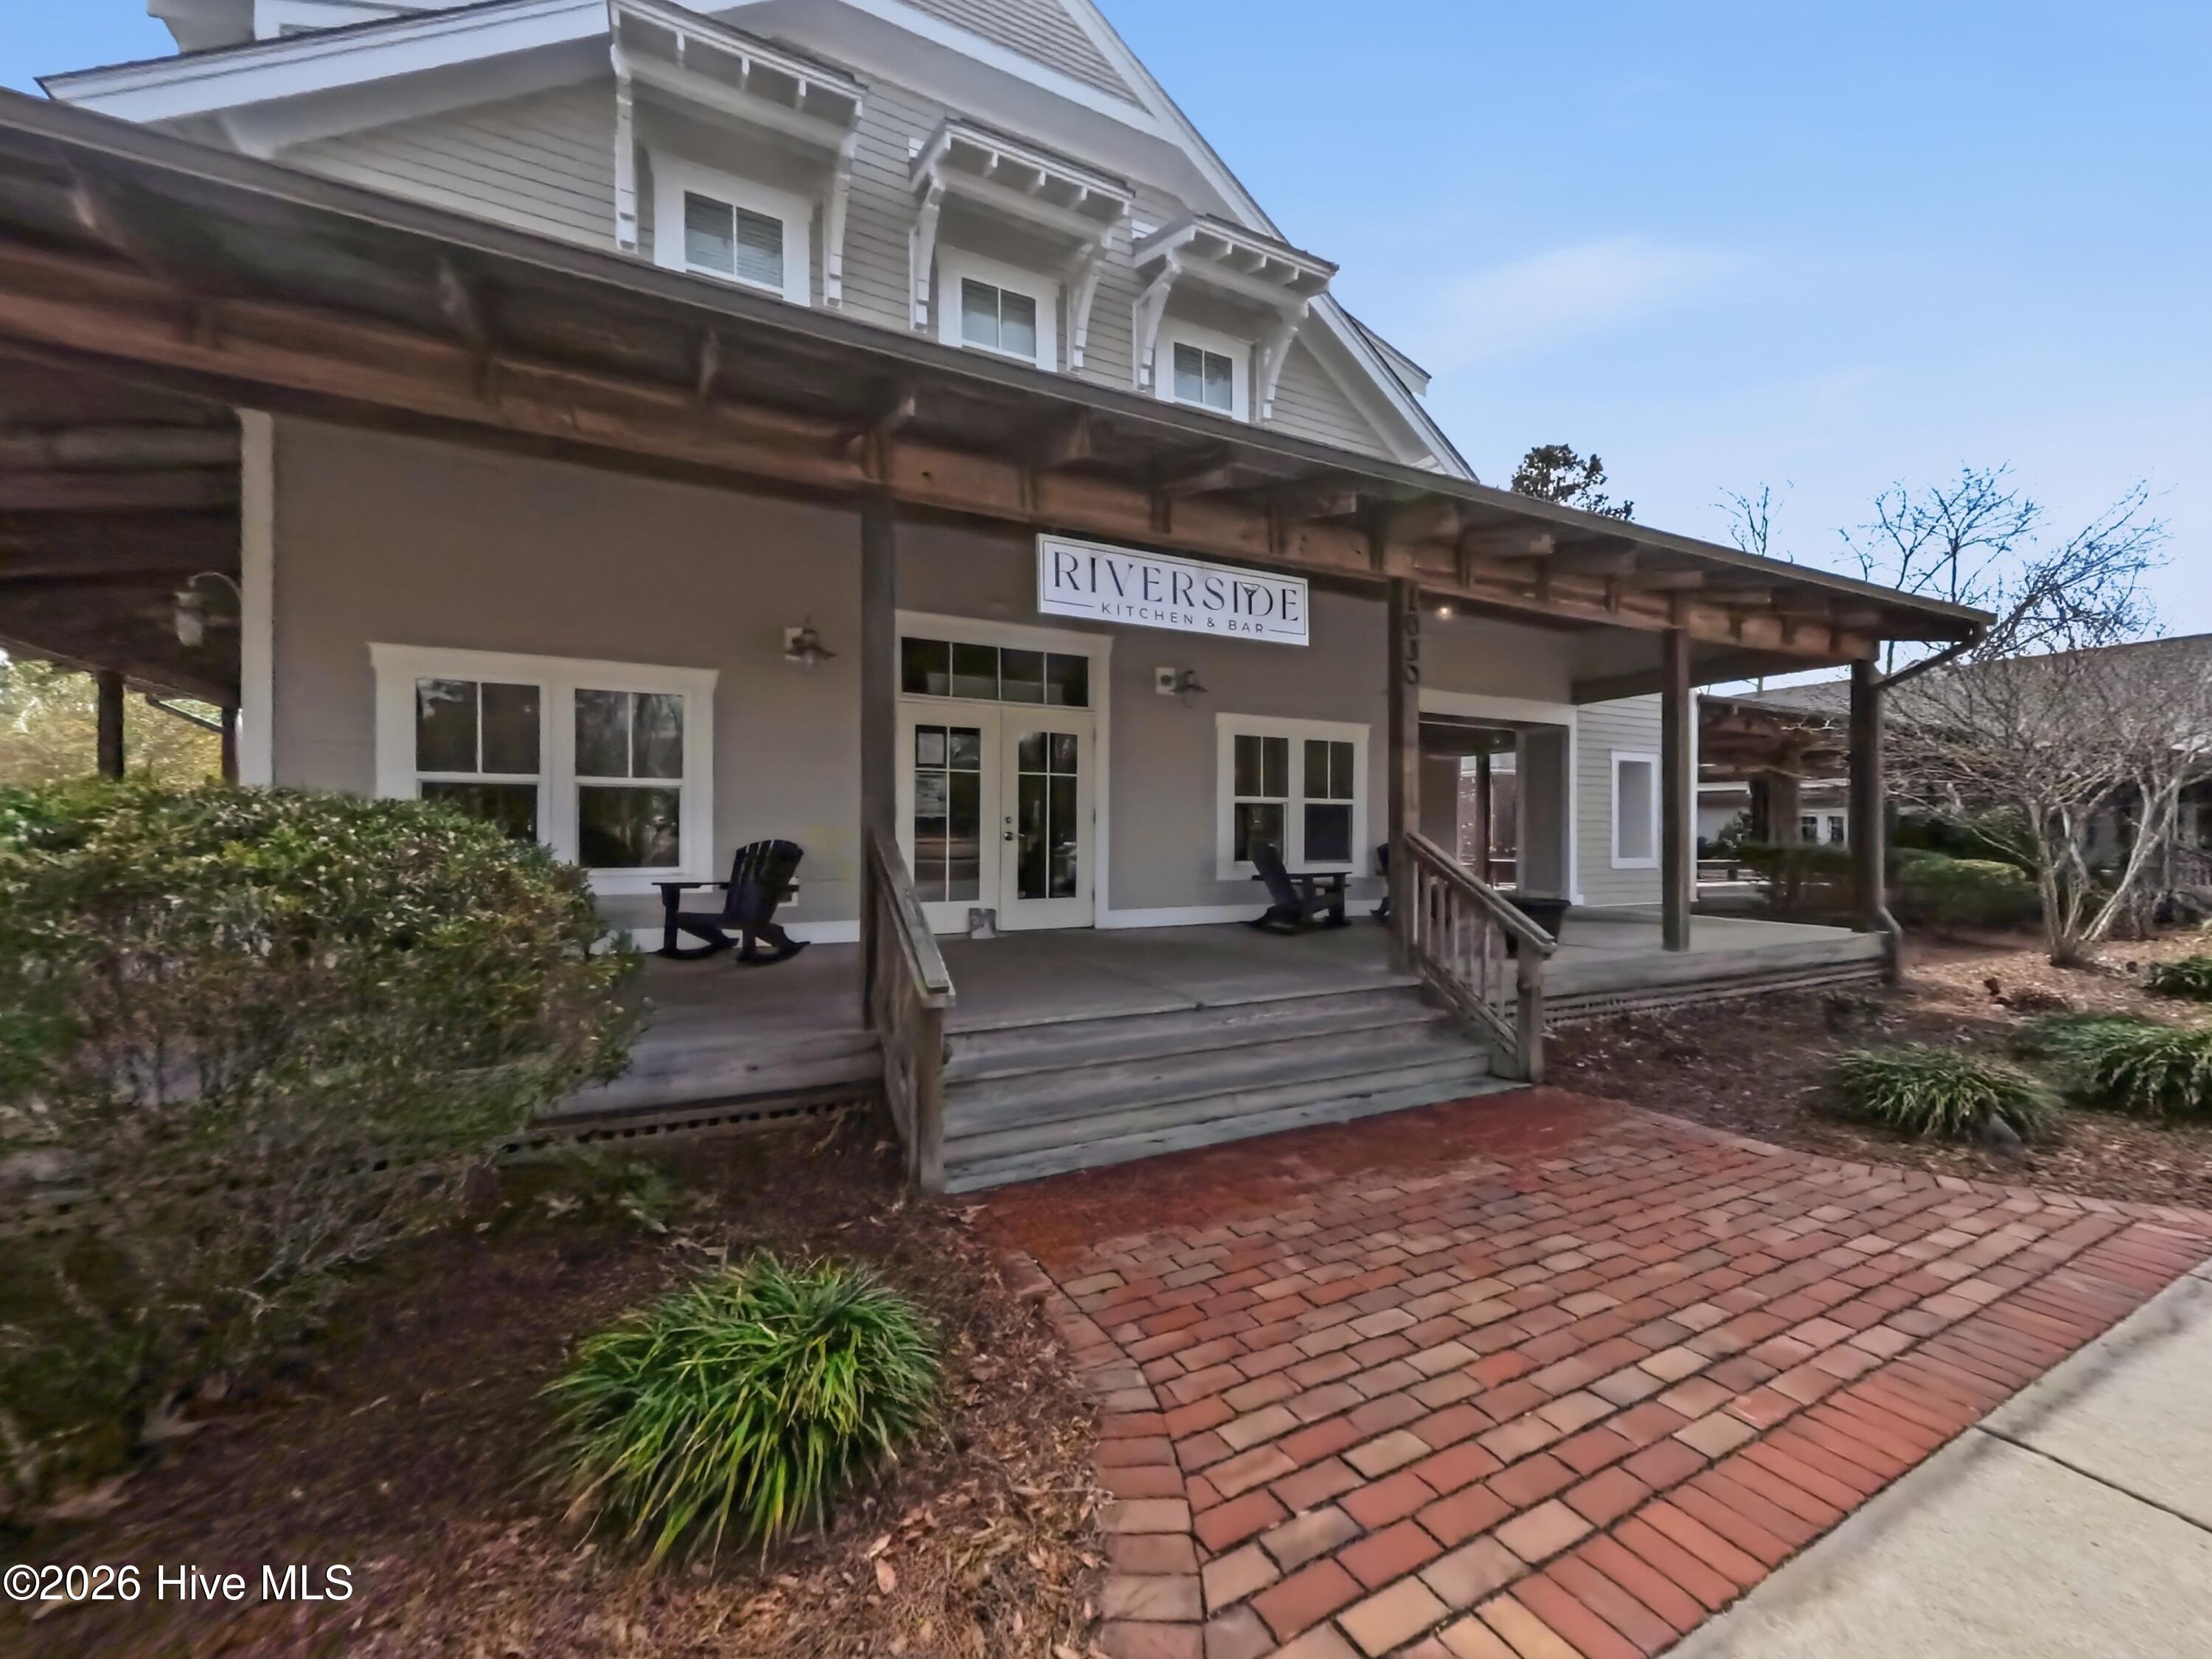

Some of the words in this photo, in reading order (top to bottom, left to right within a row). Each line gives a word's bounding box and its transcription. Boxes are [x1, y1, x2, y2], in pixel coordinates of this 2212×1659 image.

[1054, 552, 1298, 621] RIVERSIDE
[1102, 602, 1193, 625] KITCHEN
[1206, 617, 1215, 627] &
[1228, 621, 1264, 633] BAR
